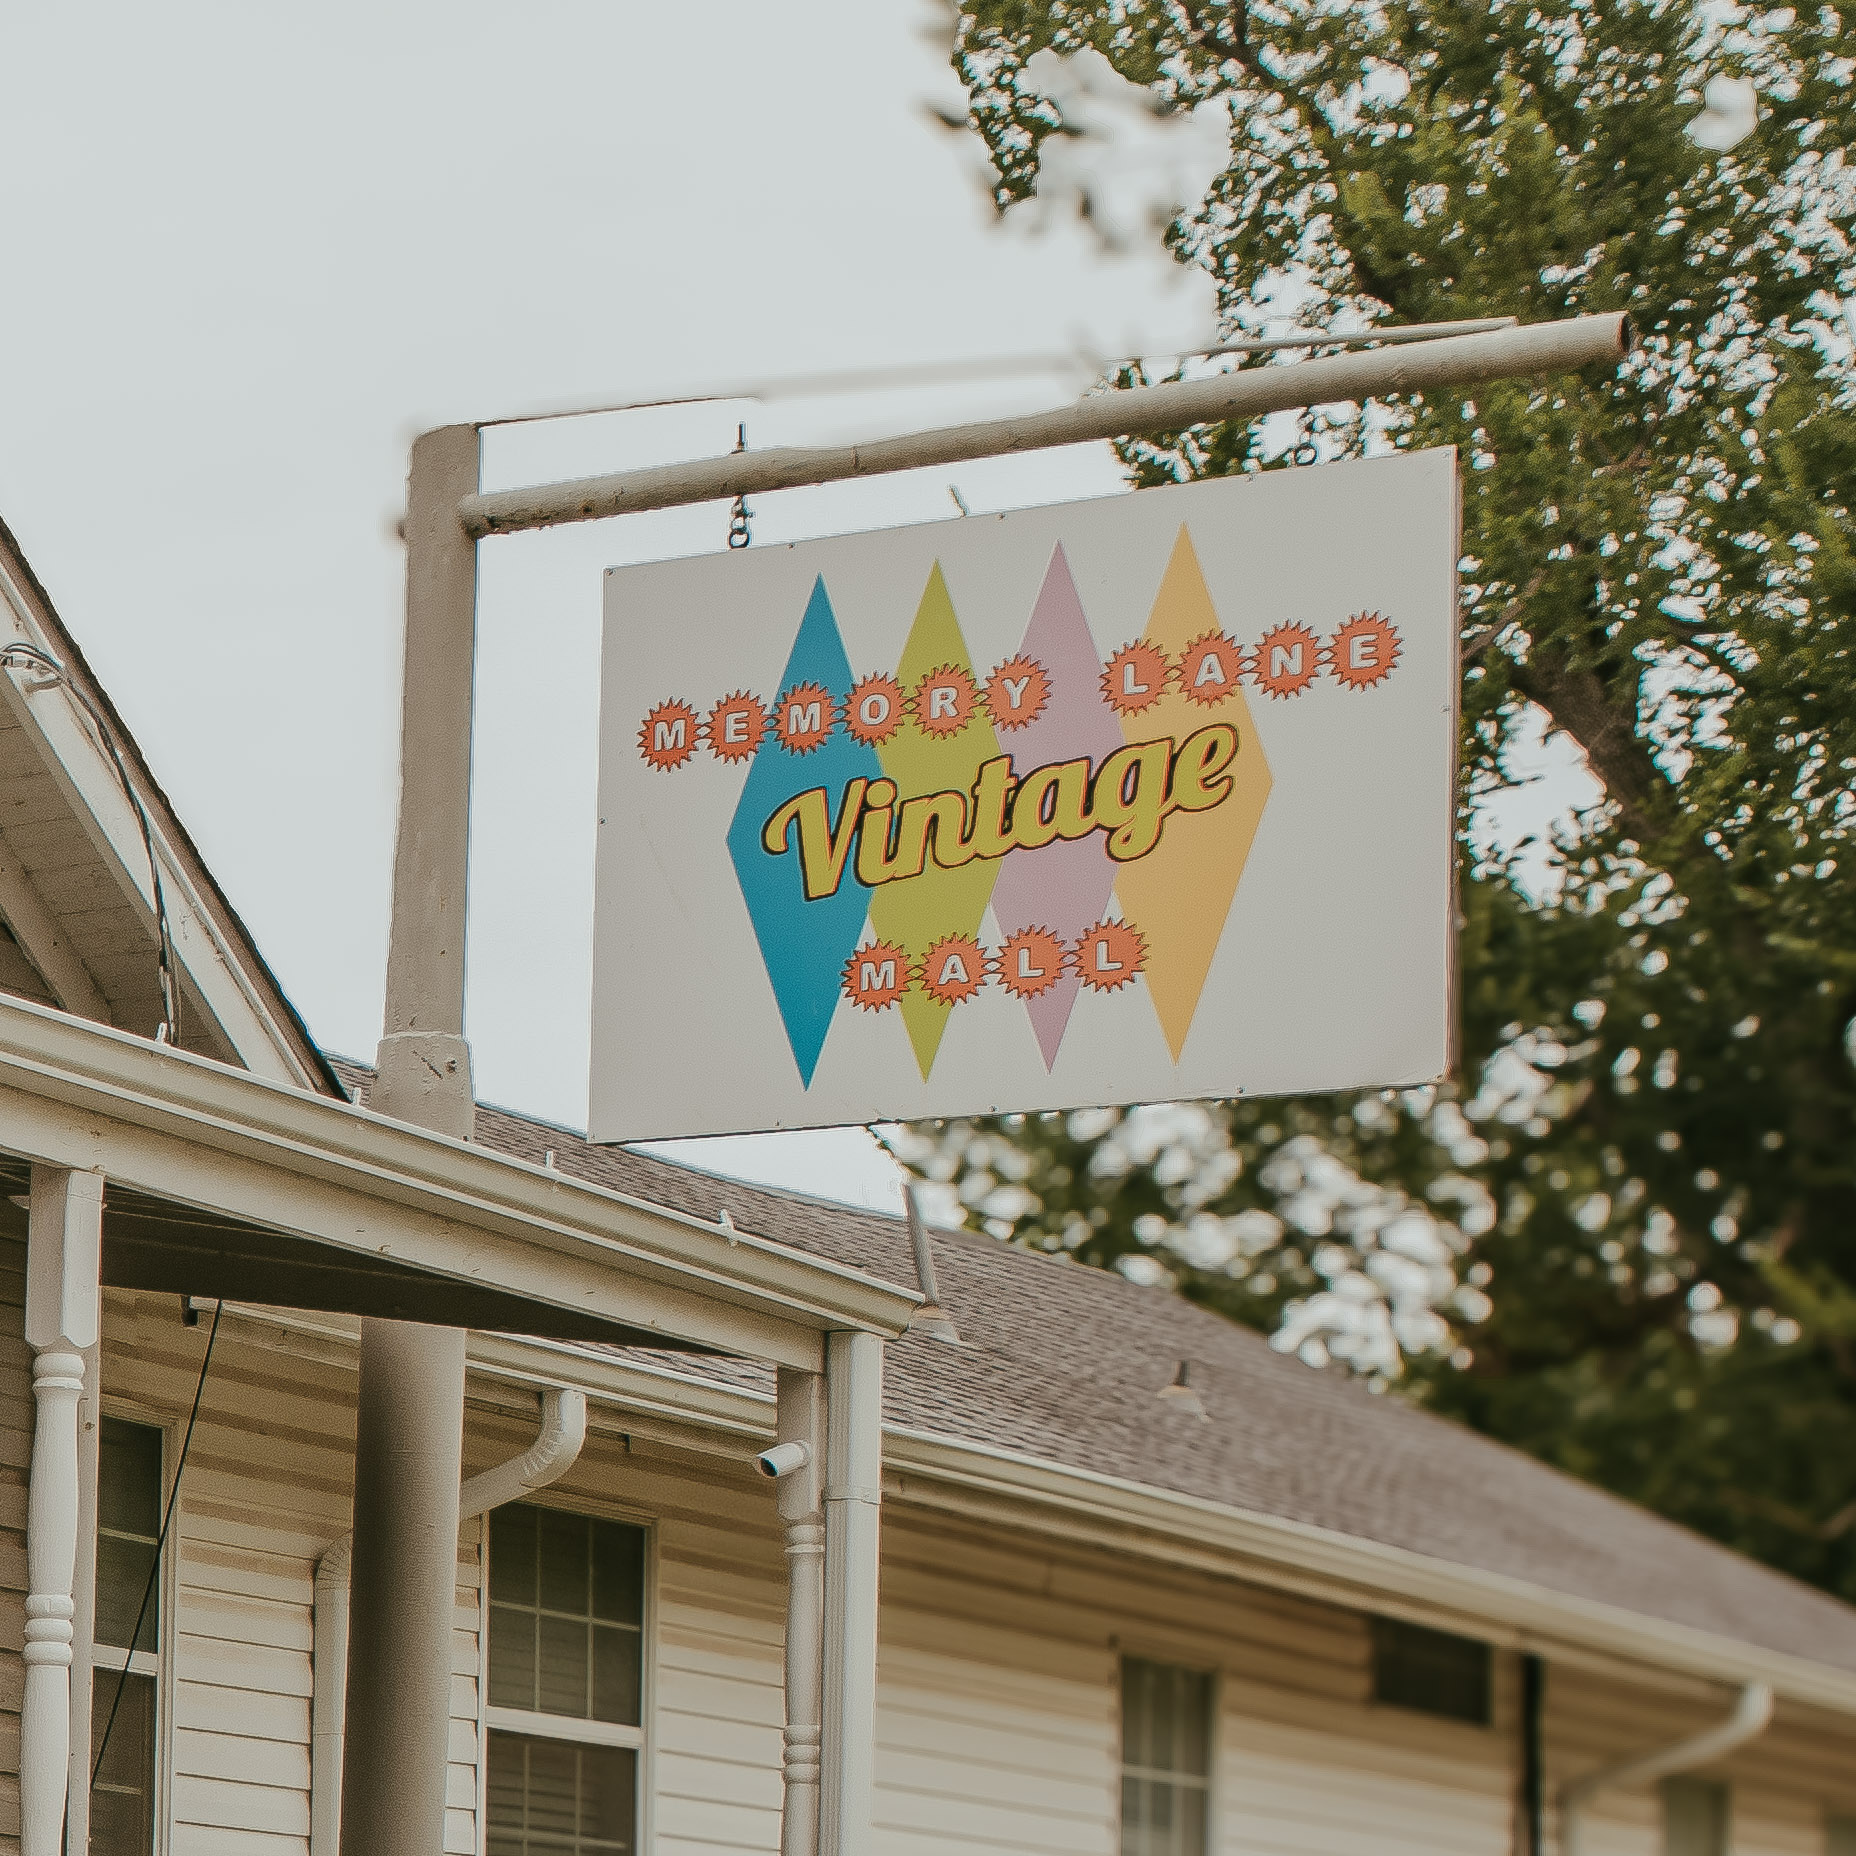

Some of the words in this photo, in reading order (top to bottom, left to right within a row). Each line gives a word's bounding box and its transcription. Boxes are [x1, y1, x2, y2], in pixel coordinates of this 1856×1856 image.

[650, 673, 1034, 755] MEMORY
[1121, 628, 1382, 698] LANE
[761, 723, 1239, 902] Vintage
[856, 937, 1128, 996] MALL
